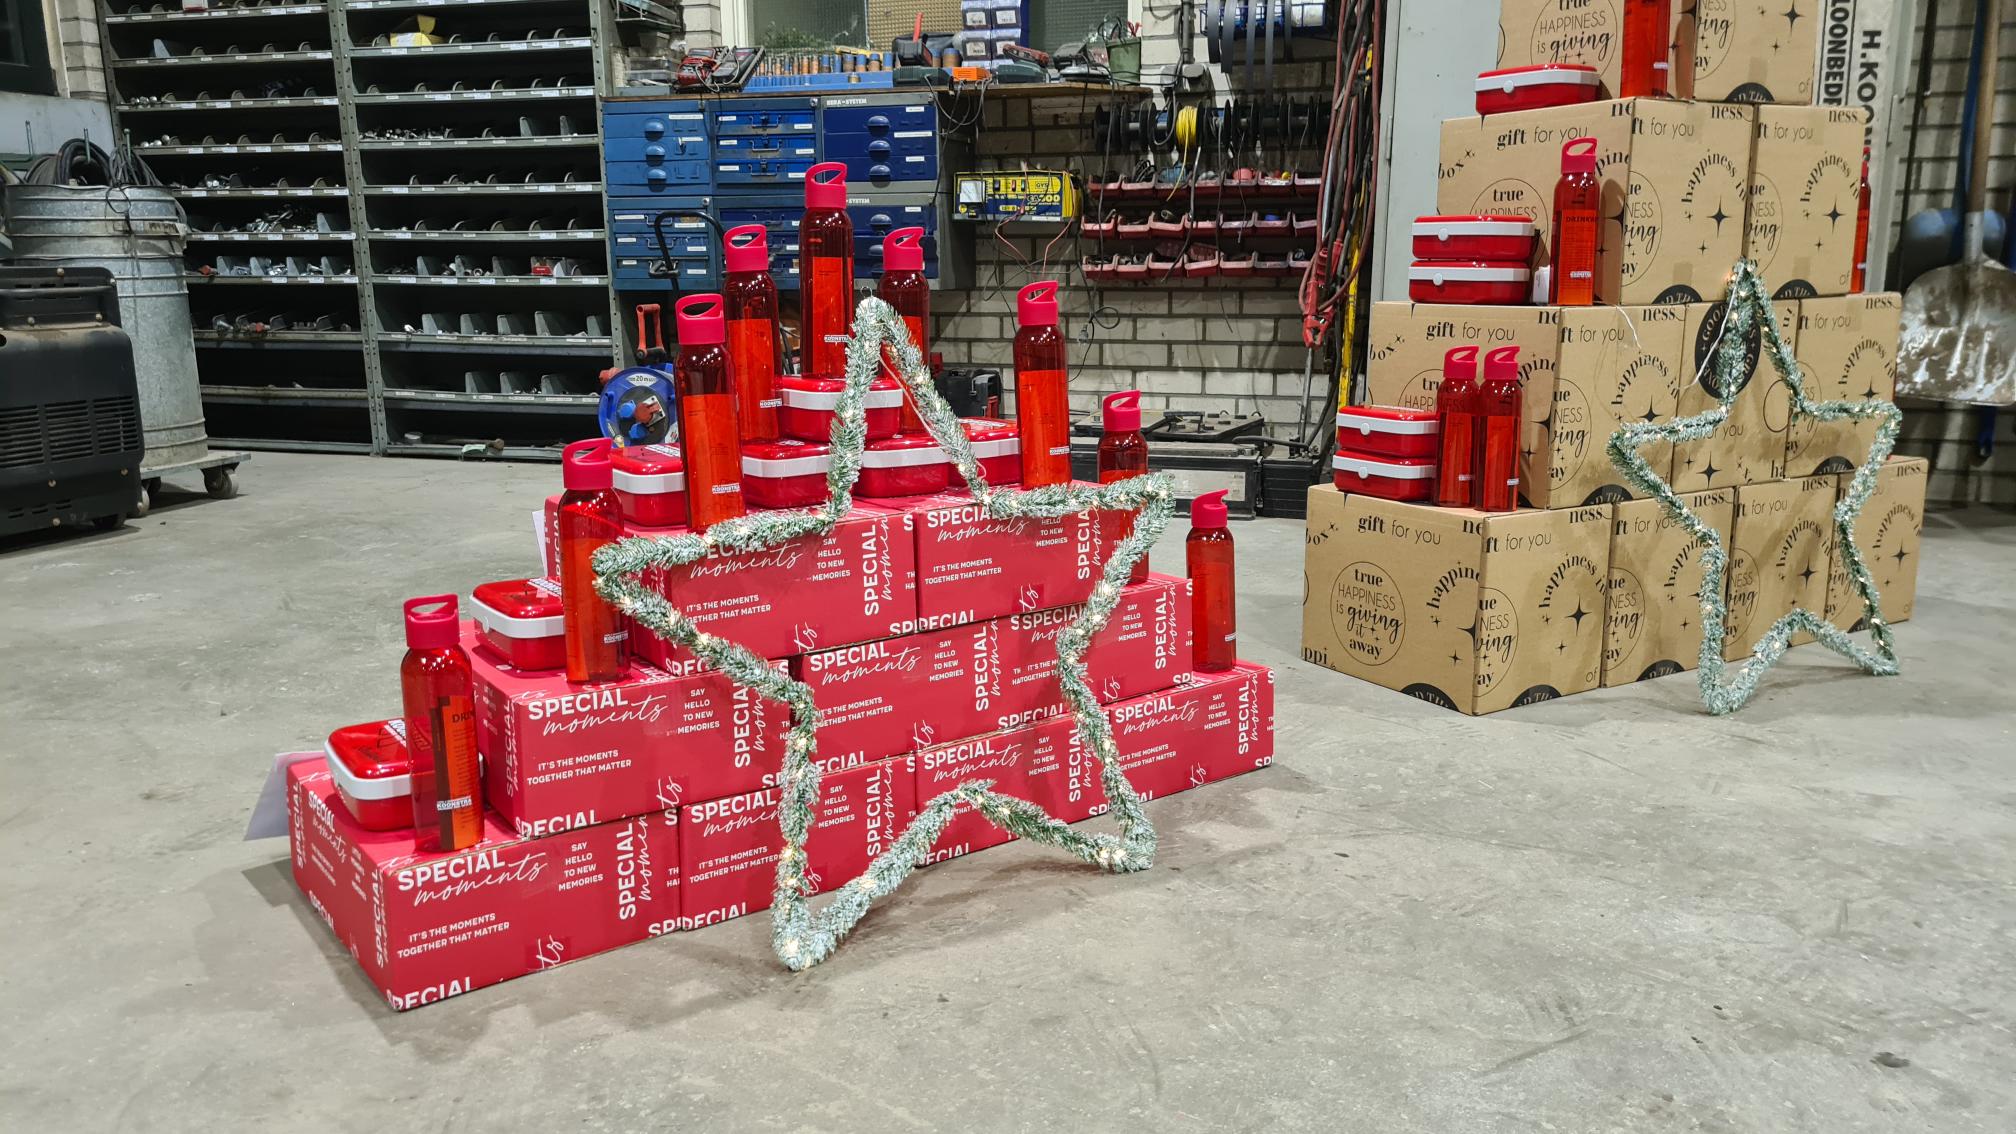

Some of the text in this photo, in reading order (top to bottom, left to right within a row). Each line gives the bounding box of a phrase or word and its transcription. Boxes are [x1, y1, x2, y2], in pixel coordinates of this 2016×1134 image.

[1540, 10, 1606, 36] HAPPINESS
[1537, 28, 1614, 63] is giving
[1711, 104, 1743, 119] ness
[1828, 109, 1858, 123] ness
[1650, 119, 1694, 139] for you
[1774, 122, 1814, 140] for you
[1497, 126, 1554, 150] gift for
[1681, 150, 1736, 203] happiness
[1801, 150, 1851, 202] happiness
[1493, 189, 1524, 202] true
[1866, 297, 1893, 310] ness
[1642, 306, 1676, 322] ness
[1814, 312, 1828, 328] for
[1426, 322, 1515, 343] gift for you
[1580, 325, 1625, 343] for you
[1838, 336, 1886, 386] happiness
[1611, 354, 1669, 406] happiness
[1896, 461, 1921, 477] ness
[1802, 476, 1829, 492] ness
[1693, 490, 1725, 507] ness
[1751, 498, 1788, 515] for you
[1569, 506, 1603, 523] ness
[938, 516, 1029, 541] moments
[1358, 515, 1441, 545] gift for you
[1635, 518, 1650, 532] for
[823, 538, 837, 546] SAY
[1036, 537, 1068, 547] MEMORIES
[1506, 533, 1552, 551] for you
[690, 543, 803, 579] moments
[817, 548, 841, 557] HELLO
[817, 559, 844, 569] TO NEW
[861, 524, 879, 616] SPECIAL
[961, 558, 992, 568] MOMENTS
[812, 570, 851, 581] MEMORIES
[925, 567, 1002, 585] TOGETHER THAT MATTER
[1355, 569, 1383, 586] true
[1538, 554, 1598, 609] happiness
[686, 594, 759, 612] IT'S THE MOMENTS
[1339, 582, 1396, 610] HAPPINESS
[720, 604, 771, 620] THAT MATTER
[1123, 612, 1140, 620] HELLO
[1155, 592, 1166, 669] SPECIAL
[1337, 600, 1403, 644] is giving
[1118, 631, 1147, 641] MEMORIES
[1355, 624, 1367, 638] it
[939, 640, 952, 648] SAY
[1350, 638, 1382, 659] away
[810, 641, 890, 672] SPECIAL
[934, 650, 956, 659] HELLO
[822, 647, 921, 686] moments
[934, 660, 959, 670] TO NEW
[973, 626, 989, 711] SPECIAL
[929, 669, 964, 682] MEMORIES
[690, 688, 705, 697] SAY
[1212, 693, 1222, 701] SAY
[529, 688, 629, 720] SPECIAL
[684, 699, 711, 710] HELLO
[833, 697, 882, 714] THE MOMENTS
[1115, 697, 1175, 723] SPECIAL
[1208, 702, 1225, 710] HELLO
[543, 695, 668, 736] moments
[684, 710, 714, 722] TO NEW
[848, 705, 893, 722] THAT MATTER
[1124, 700, 1199, 735] moments
[1238, 681, 1249, 755] SPECIAL
[677, 720, 720, 735] MEMORIES
[1204, 719, 1231, 730] MEMORIES
[924, 740, 995, 770] SPECIAL
[1034, 746, 1053, 754] HELLO
[1131, 744, 1169, 760] THE MOMENTS
[1156, 751, 1177, 762] MATTER
[538, 750, 618, 772] IT'S THE MOMENTS
[933, 744, 1023, 782] moments
[1042, 755, 1055, 763] NEW
[1069, 729, 1081, 802] SPECIAL
[527, 759, 632, 786] TOGETHER THAT MATTER
[1028, 763, 1059, 776] MEMORIES
[830, 785, 843, 793] SAY
[690, 790, 776, 823] SPECIAL
[824, 795, 847, 805] HELLO
[824, 805, 849, 816] TO NEW
[867, 770, 881, 856] SPECIAL
[818, 814, 855, 829] MEMORIES
[571, 842, 587, 852] SAY
[565, 853, 593, 865] HELLO
[698, 846, 768, 870] IT'S THE MOMENTS
[397, 849, 506, 891] SPECIAL
[564, 863, 596, 878] TO NEW
[616, 822, 636, 920] SPECIAL
[689, 854, 779, 884] TOGETHER THAT MATTER
[414, 852, 548, 906] moments
[558, 873, 604, 891] MEMORIES
[409, 913, 496, 943] IT'S THE MOMENTS
[397, 921, 510, 958] TOGETHER THAT MATTER
